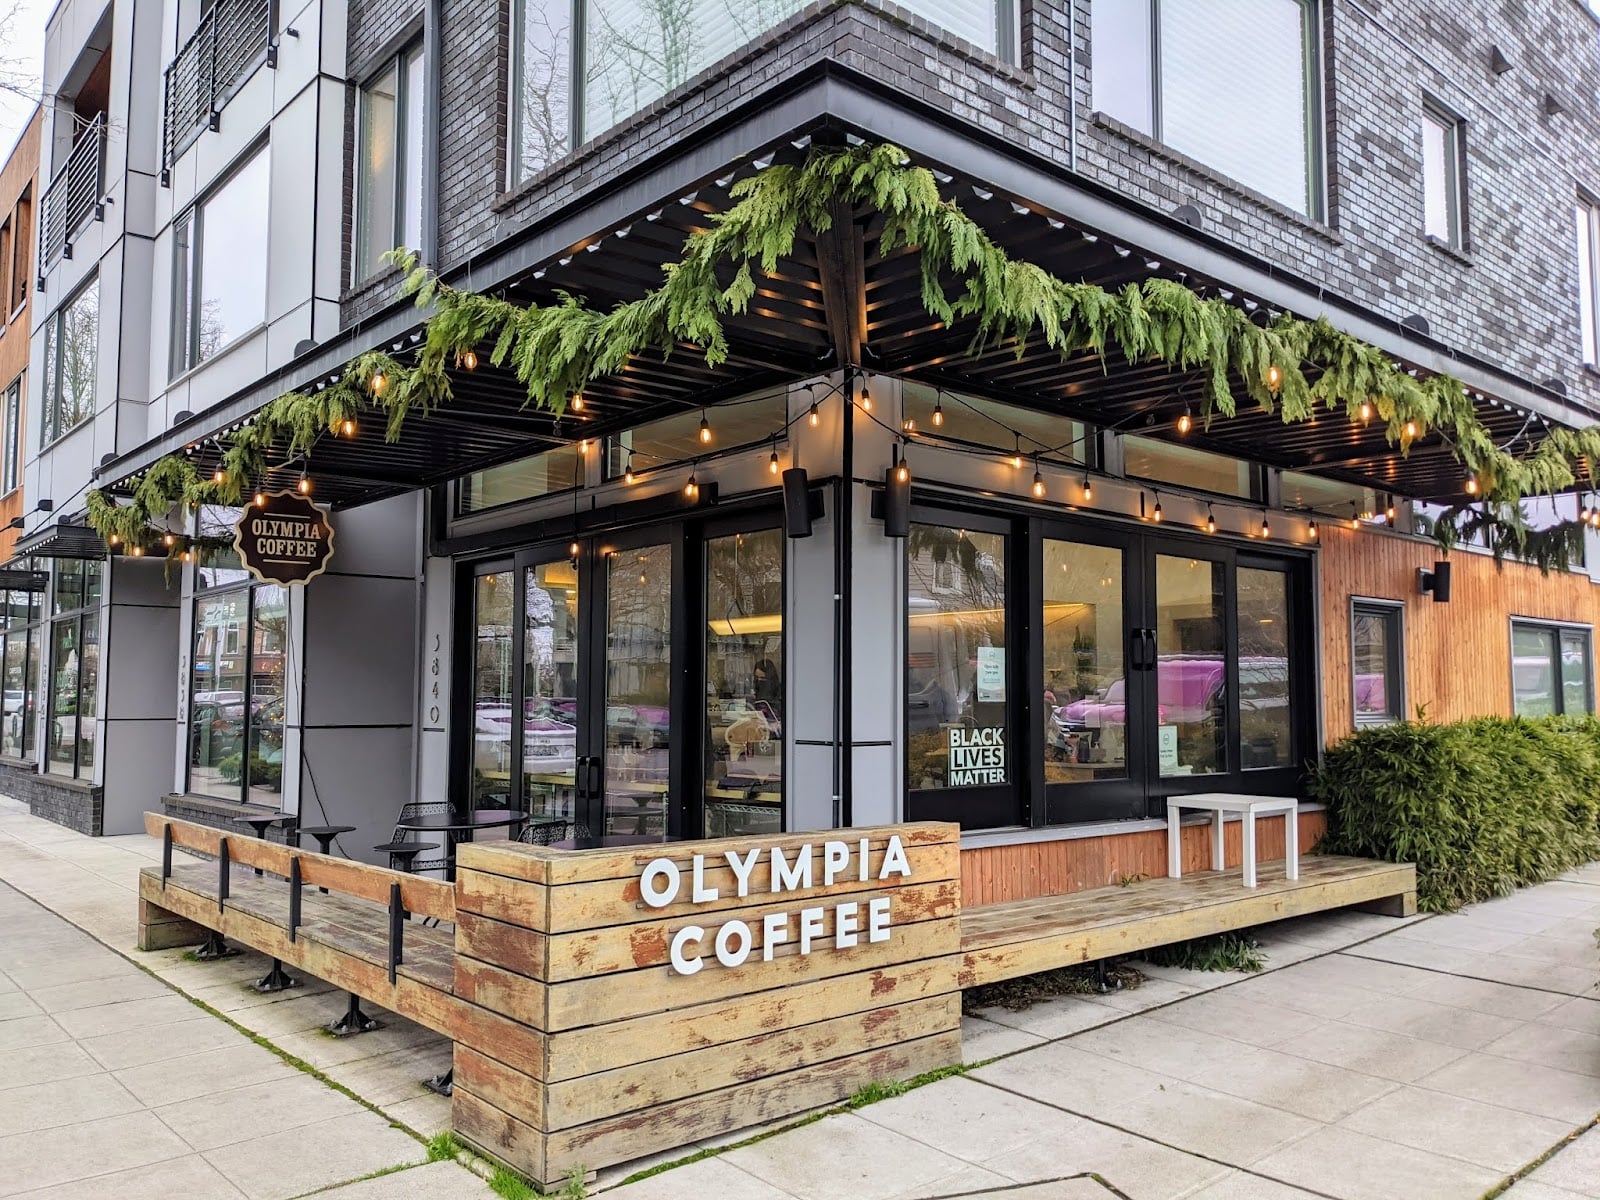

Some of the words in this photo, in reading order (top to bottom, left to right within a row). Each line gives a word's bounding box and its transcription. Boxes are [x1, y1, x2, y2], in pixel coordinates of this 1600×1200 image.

[251, 518, 321, 540] OLYMPIA
[256, 537, 317, 558] COFFEE
[950, 727, 1004, 747] BLACK
[953, 747, 1002, 768] LIVES
[951, 768, 1006, 786] MATTER
[640, 835, 912, 908] OLYMPIA
[670, 897, 891, 976] COFFEE
